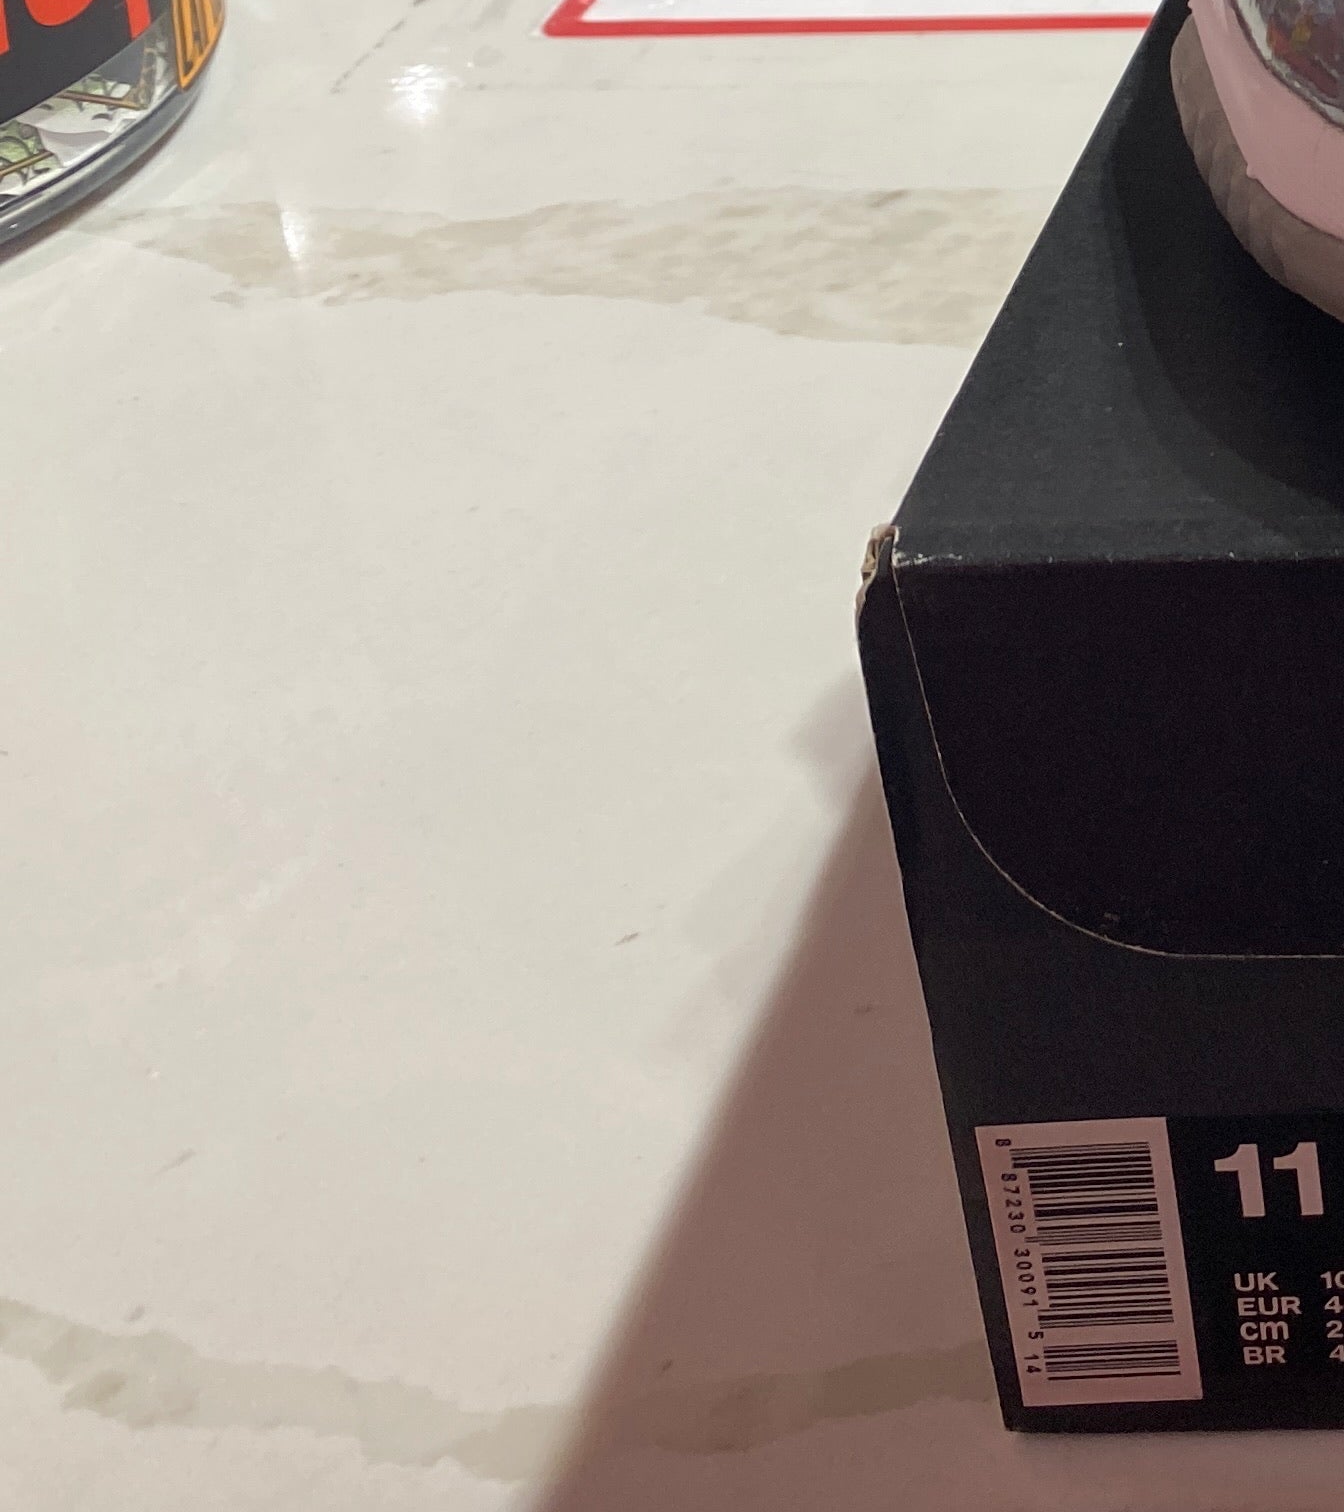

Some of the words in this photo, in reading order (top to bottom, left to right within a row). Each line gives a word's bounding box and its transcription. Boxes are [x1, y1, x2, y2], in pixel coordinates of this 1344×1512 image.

[1213, 1141, 1325, 1219] 11
[1001, 1172, 1026, 1235] 87230
[1014, 1248, 1040, 1308] 30091
[1234, 1272, 1280, 1292] UK
[1238, 1297, 1303, 1317] EUR
[1240, 1321, 1290, 1341] cm
[1244, 1346, 1287, 1365] BR
